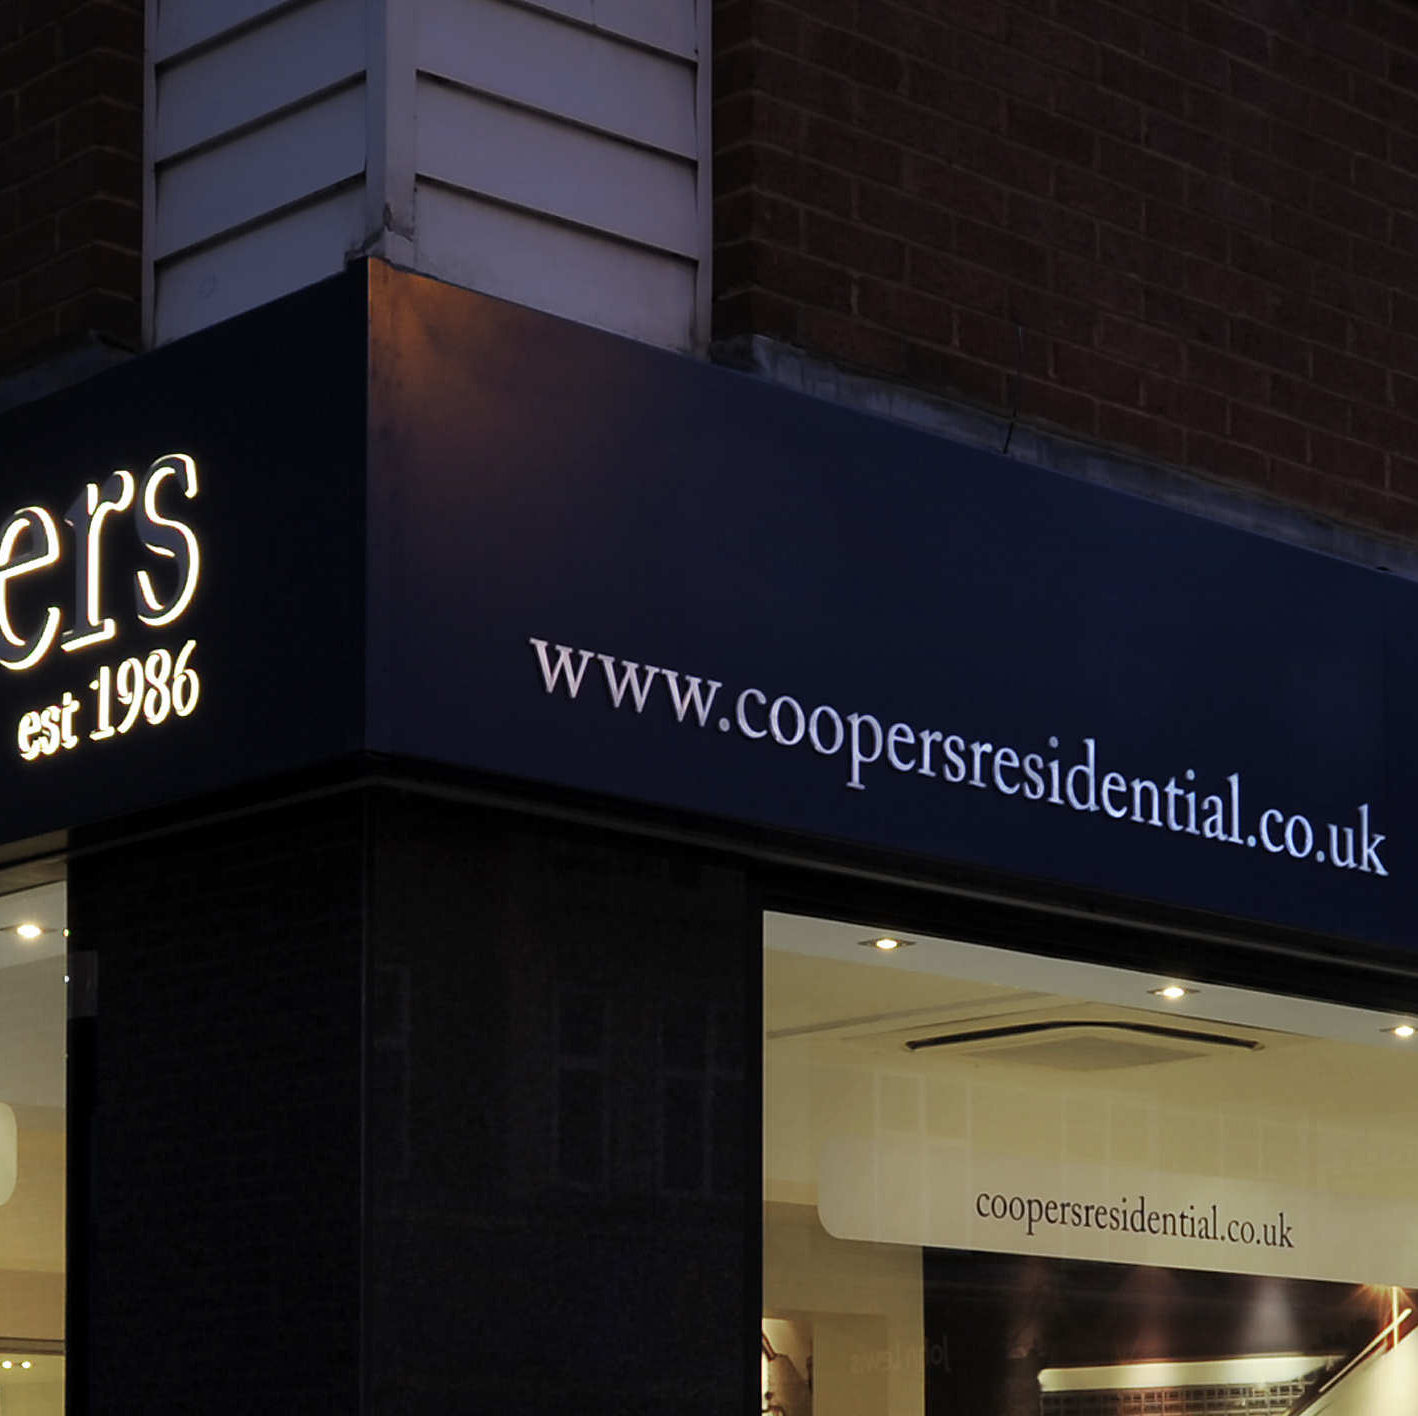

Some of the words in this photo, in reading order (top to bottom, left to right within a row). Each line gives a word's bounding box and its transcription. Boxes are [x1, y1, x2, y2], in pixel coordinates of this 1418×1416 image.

[17, 692, 79, 760] est
[89, 639, 200, 741] 1986
[528, 637, 1389, 877] www.coopersresidential.co.uk
[975, 1186, 1295, 1250] coopersresidential.co.uk
